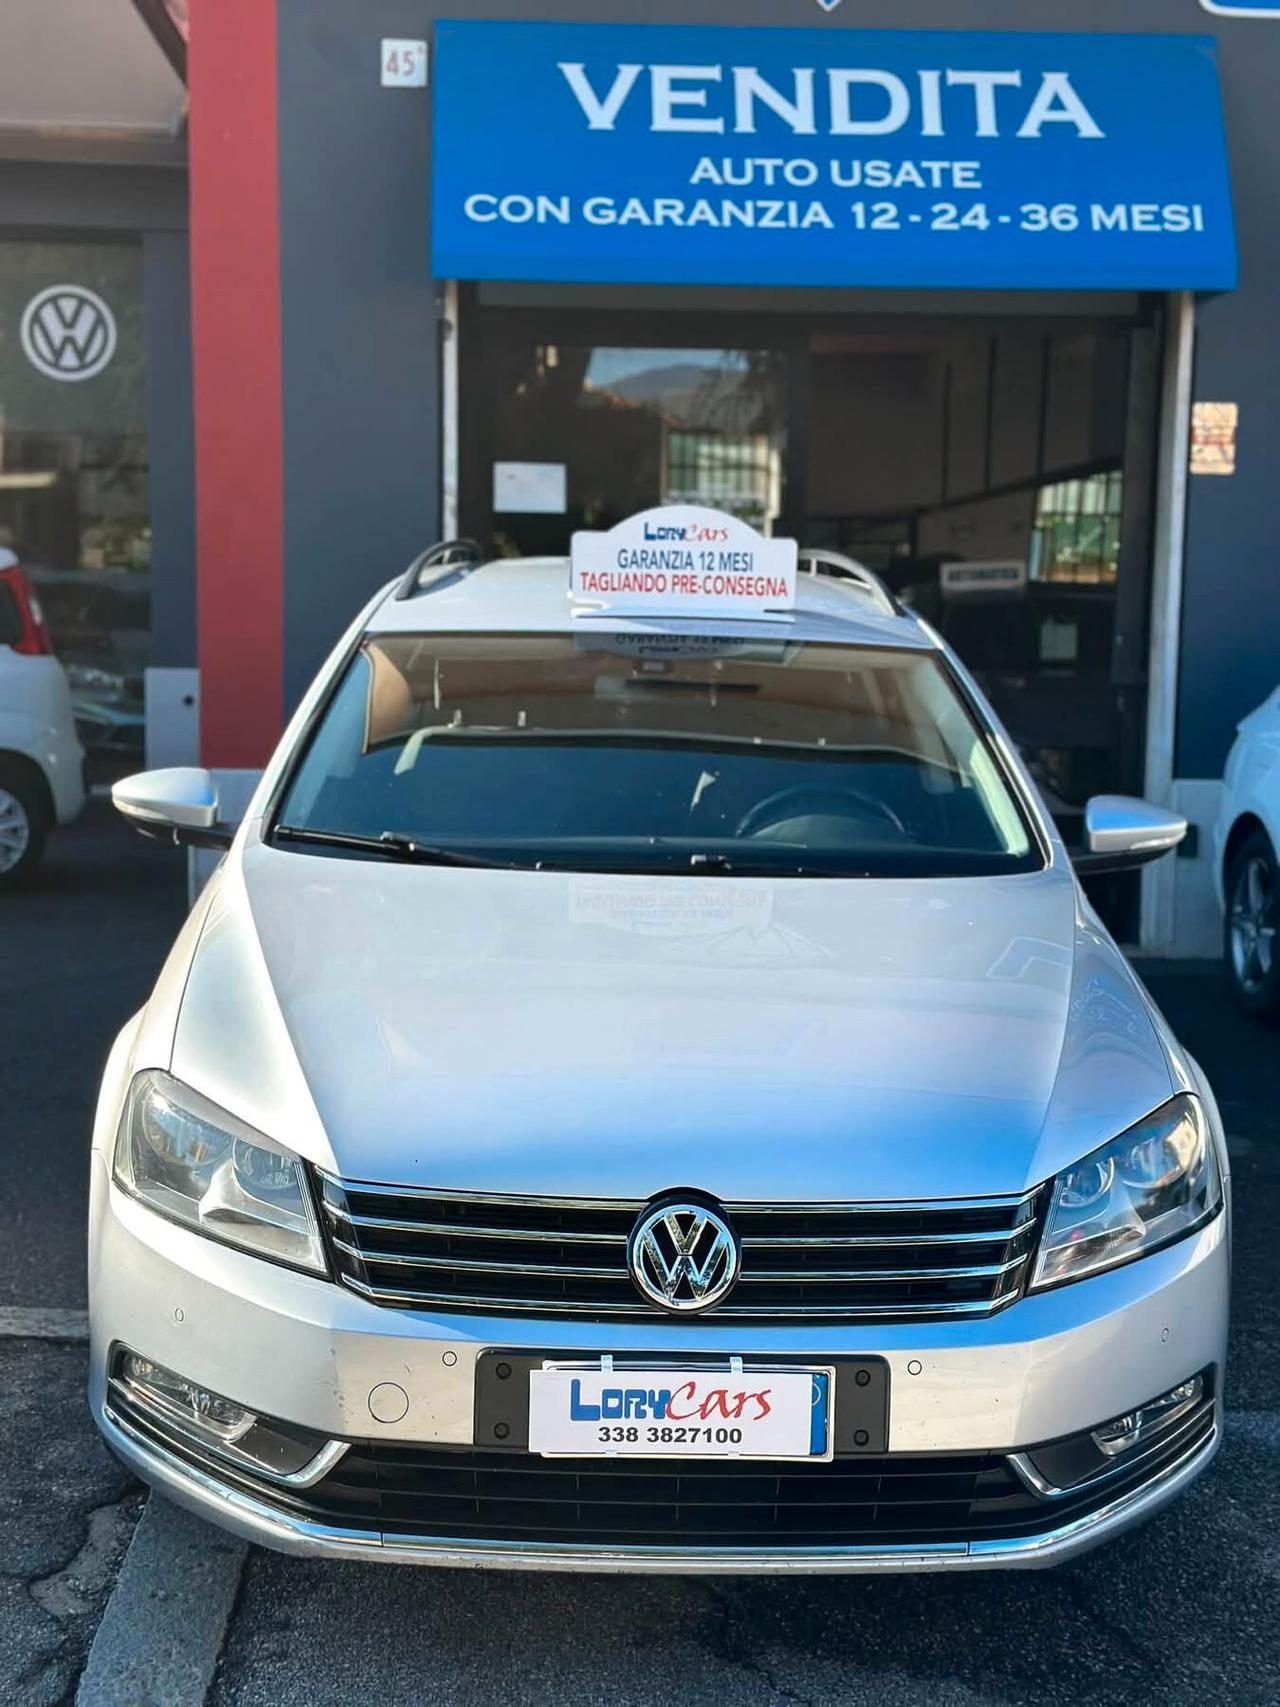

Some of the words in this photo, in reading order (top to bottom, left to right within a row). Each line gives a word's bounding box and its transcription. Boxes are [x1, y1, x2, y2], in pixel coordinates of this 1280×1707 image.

[559, 63, 1105, 138] VENDITA
[690, 157, 819, 187] AUTO
[830, 160, 982, 189] USATE
[464, 194, 571, 225] CON
[582, 196, 834, 229] GARANZIA
[852, 202, 900, 230] 12
[931, 203, 990, 231] 24
[1020, 203, 1079, 231] 36
[1090, 204, 1204, 232] MESI
[617, 549, 695, 570] GARANZIA
[699, 551, 716, 571] 12
[718, 552, 754, 573] MESI
[581, 571, 668, 593] TAGLIANDO
[671, 574, 788, 598] PRE-CONSEGNA
[598, 1426, 640, 1443] 338
[646, 1427, 742, 1444] 3827100
